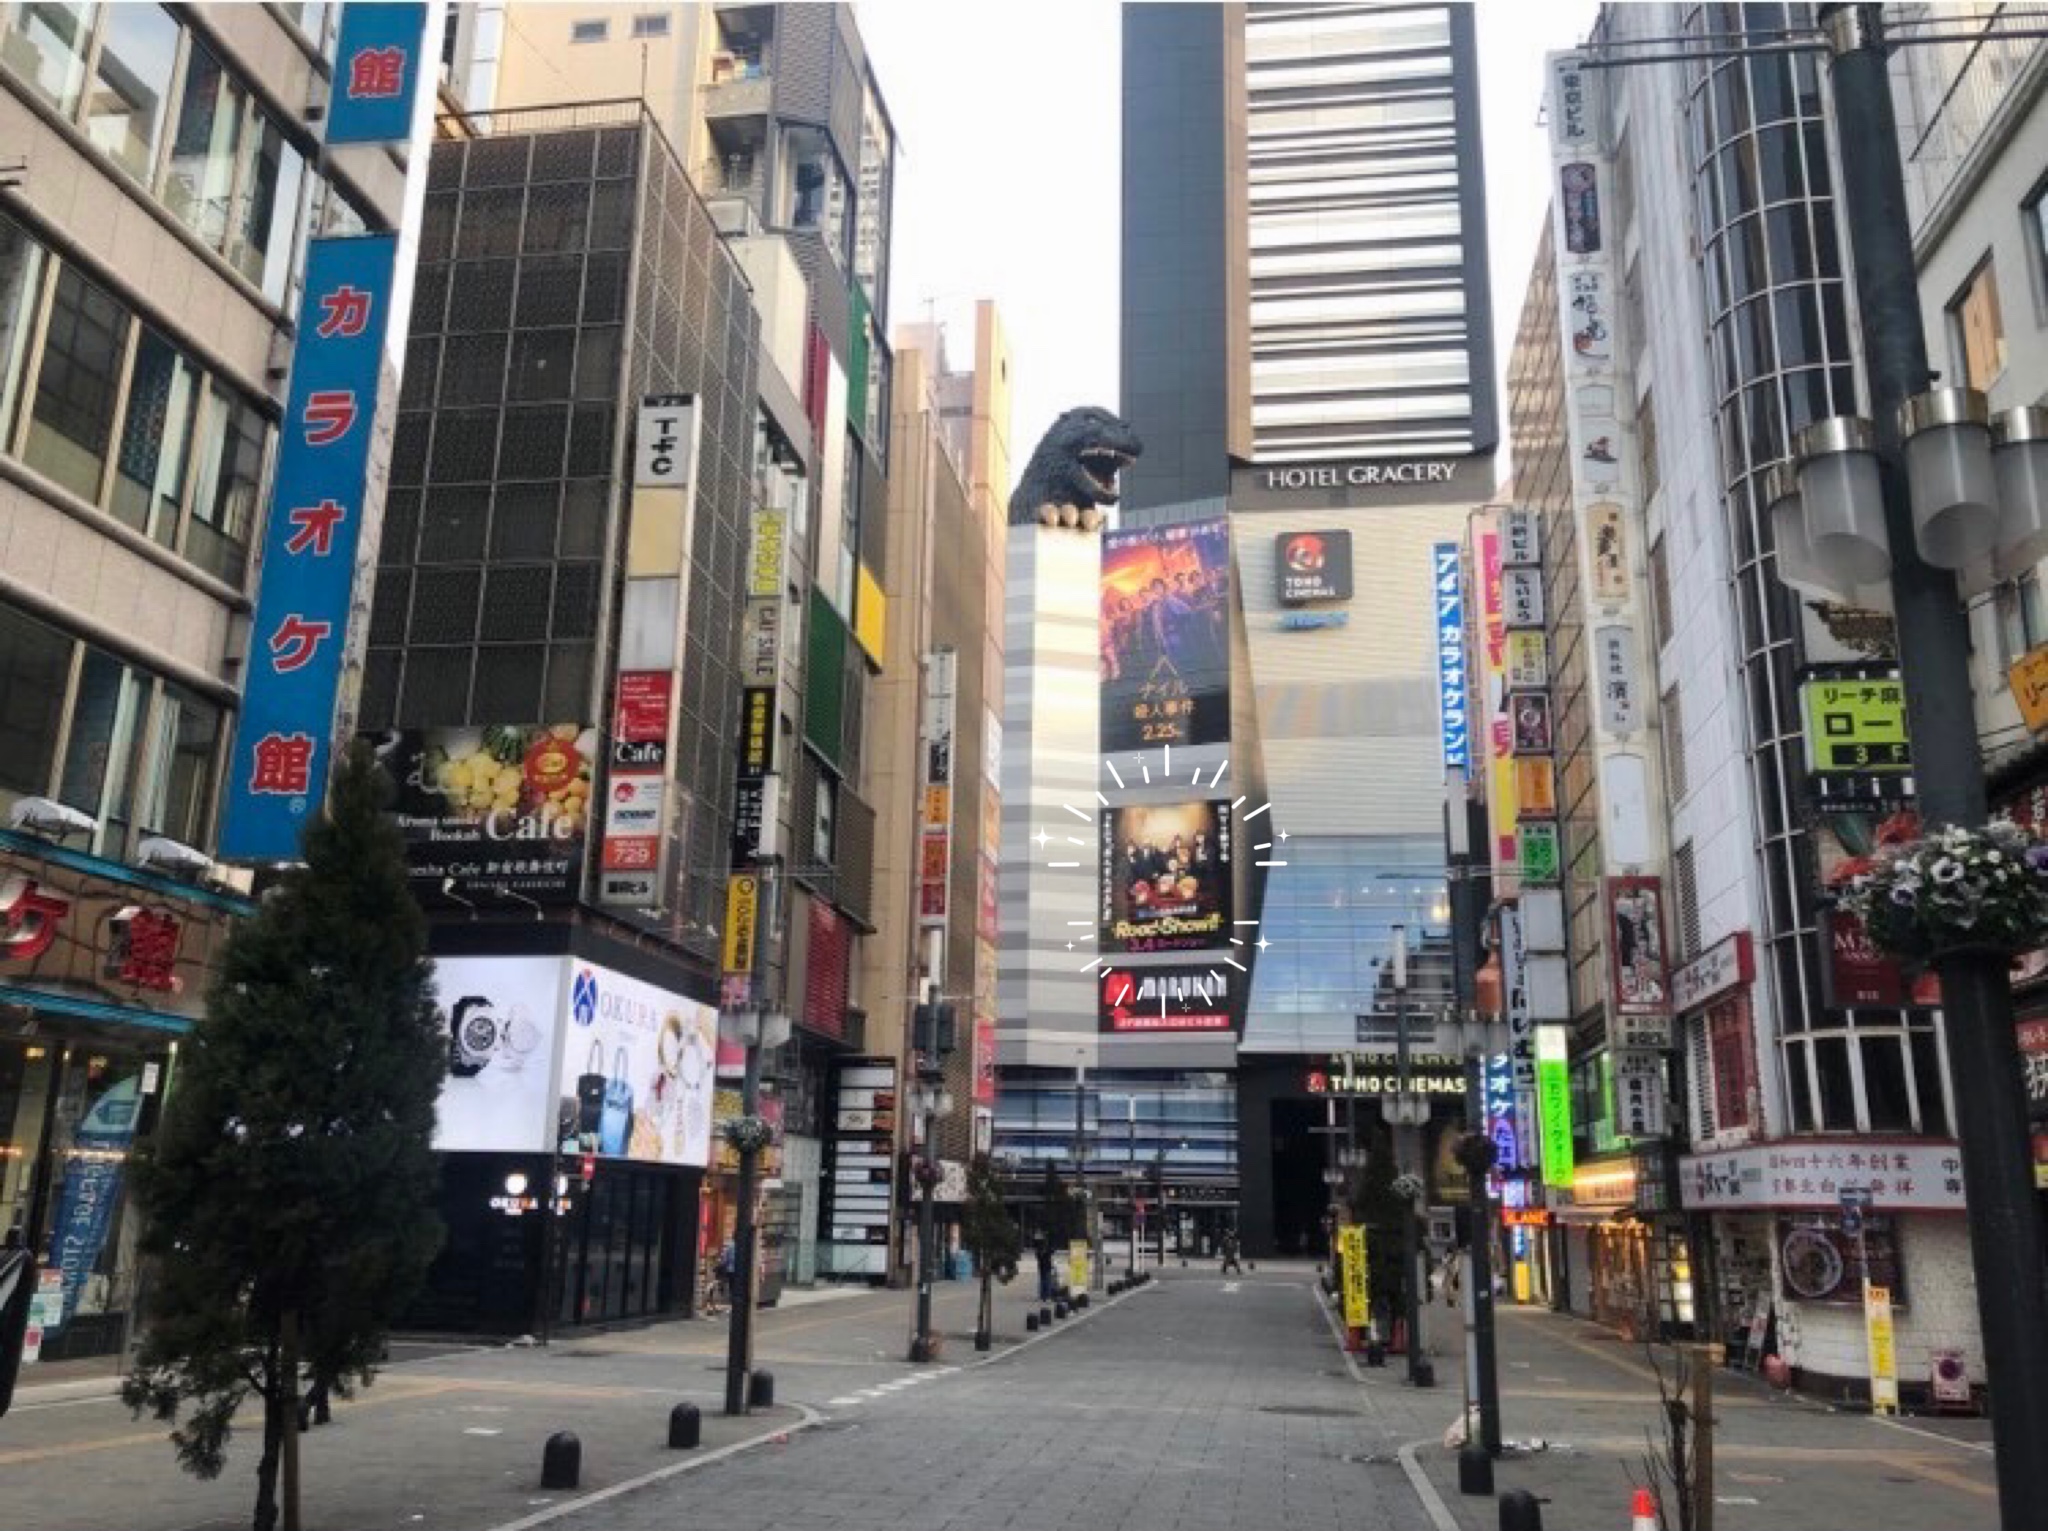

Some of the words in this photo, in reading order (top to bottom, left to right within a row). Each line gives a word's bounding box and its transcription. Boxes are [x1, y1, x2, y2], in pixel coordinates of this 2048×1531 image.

[347, 45, 407, 98] 館
[1269, 468, 1343, 489] HOTEL
[1348, 463, 1457, 485] GRACERY
[249, 286, 371, 796] カラオケ館
[1285, 576, 1322, 588] TOHO
[1823, 710, 1909, 738] ロー
[616, 742, 662, 763] Cafe
[485, 806, 573, 841] Cafe
